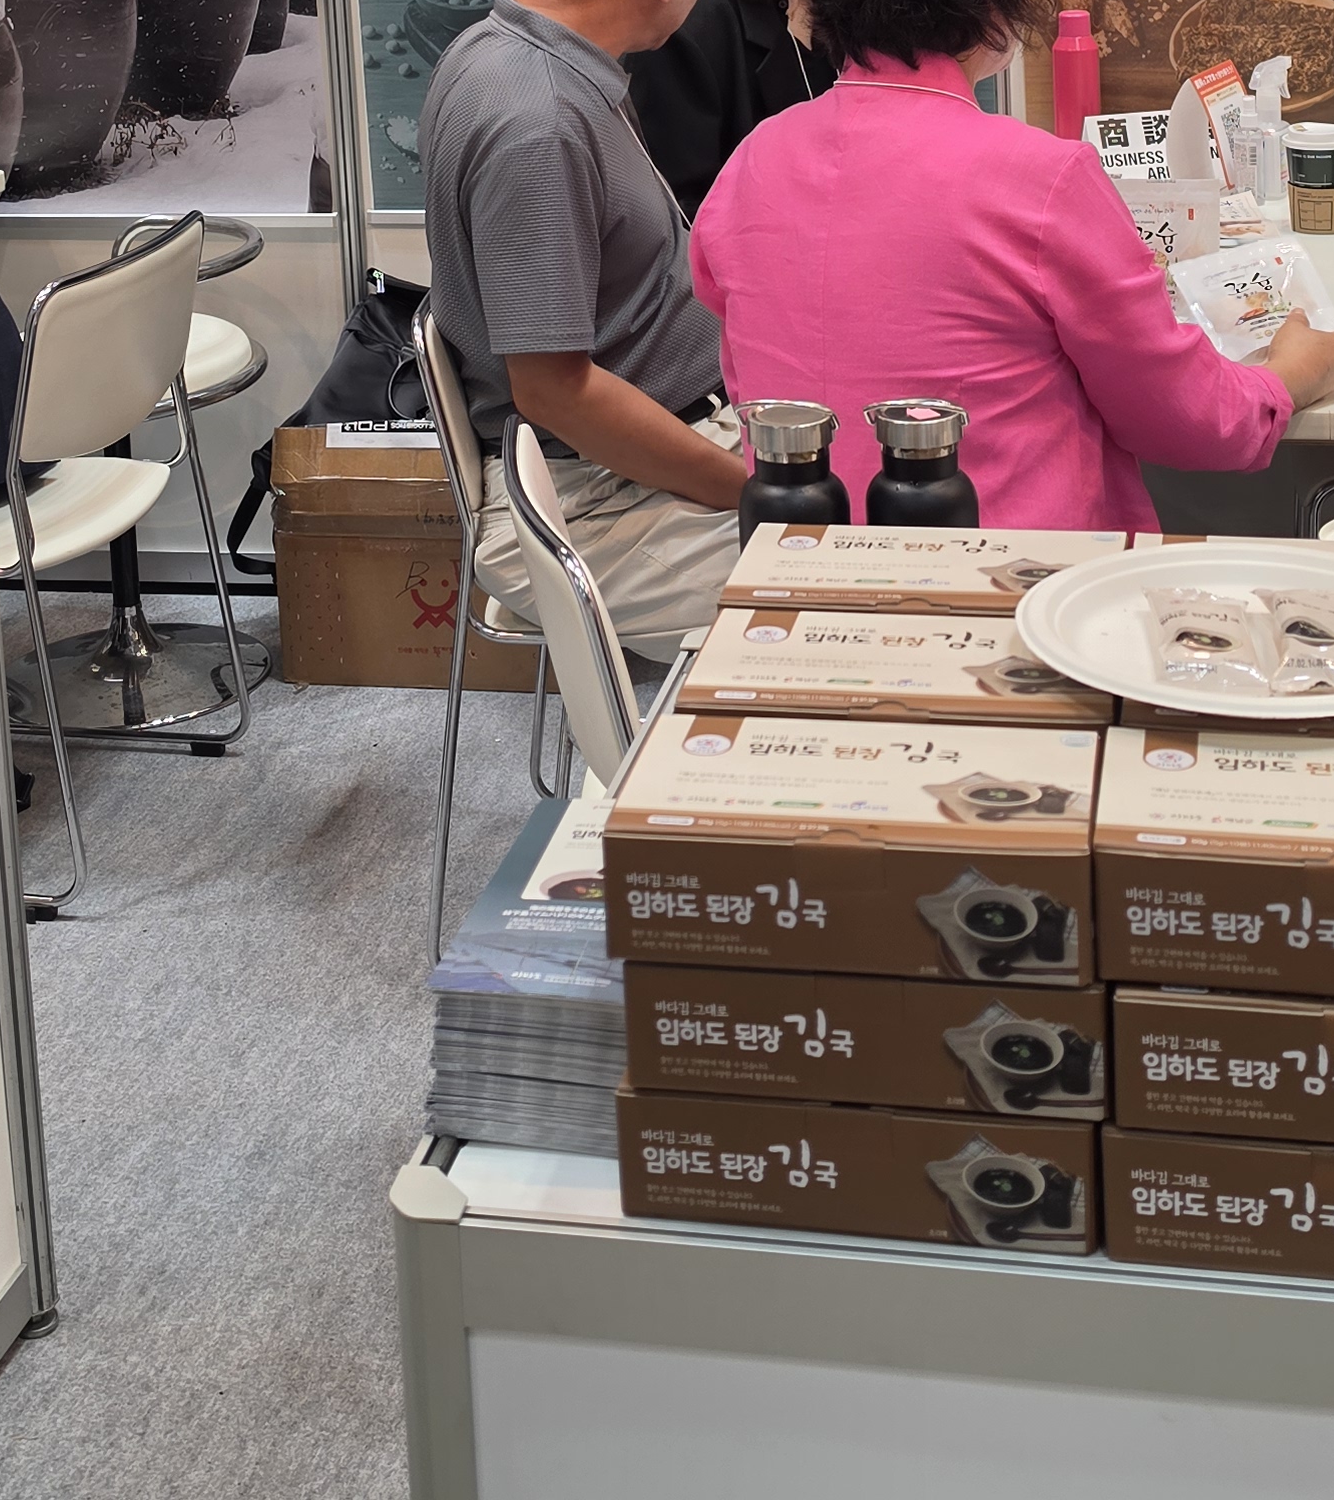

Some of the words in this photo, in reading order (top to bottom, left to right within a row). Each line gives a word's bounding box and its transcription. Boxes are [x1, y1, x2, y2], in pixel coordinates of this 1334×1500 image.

[749, 742, 823, 758] 임하도
[832, 746, 884, 761] 된장
[1214, 758, 1296, 774] 임하도
[626, 873, 661, 887] 바다김
[665, 874, 701, 888] 그대로
[1126, 888, 1164, 904] 바다김
[1167, 890, 1205, 905] 그대로
[627, 891, 699, 918] 임하도
[706, 894, 755, 924] 된장
[1126, 907, 1203, 936] 임하도
[1211, 912, 1263, 943] 된장
[655, 1001, 690, 1016] 바다김
[693, 1002, 728, 1017] 그대로
[656, 1018, 728, 1046] 임하도
[734, 1023, 783, 1053] 된장
[1142, 1034, 1180, 1050] 바다김
[1183, 1037, 1221, 1052] 그대로
[1142, 1053, 1220, 1082] 임하도
[1227, 1059, 1279, 1089] 된장
[641, 1129, 676, 1145] 바다김
[679, 1131, 714, 1146] 그대로
[642, 1147, 713, 1174] 임하도
[720, 1152, 767, 1182] 된장
[1131, 1168, 1168, 1185] 바다김
[1171, 1171, 1210, 1188] 그대로
[1132, 1187, 1209, 1217] 임하도
[1215, 1194, 1268, 1226] 된장
